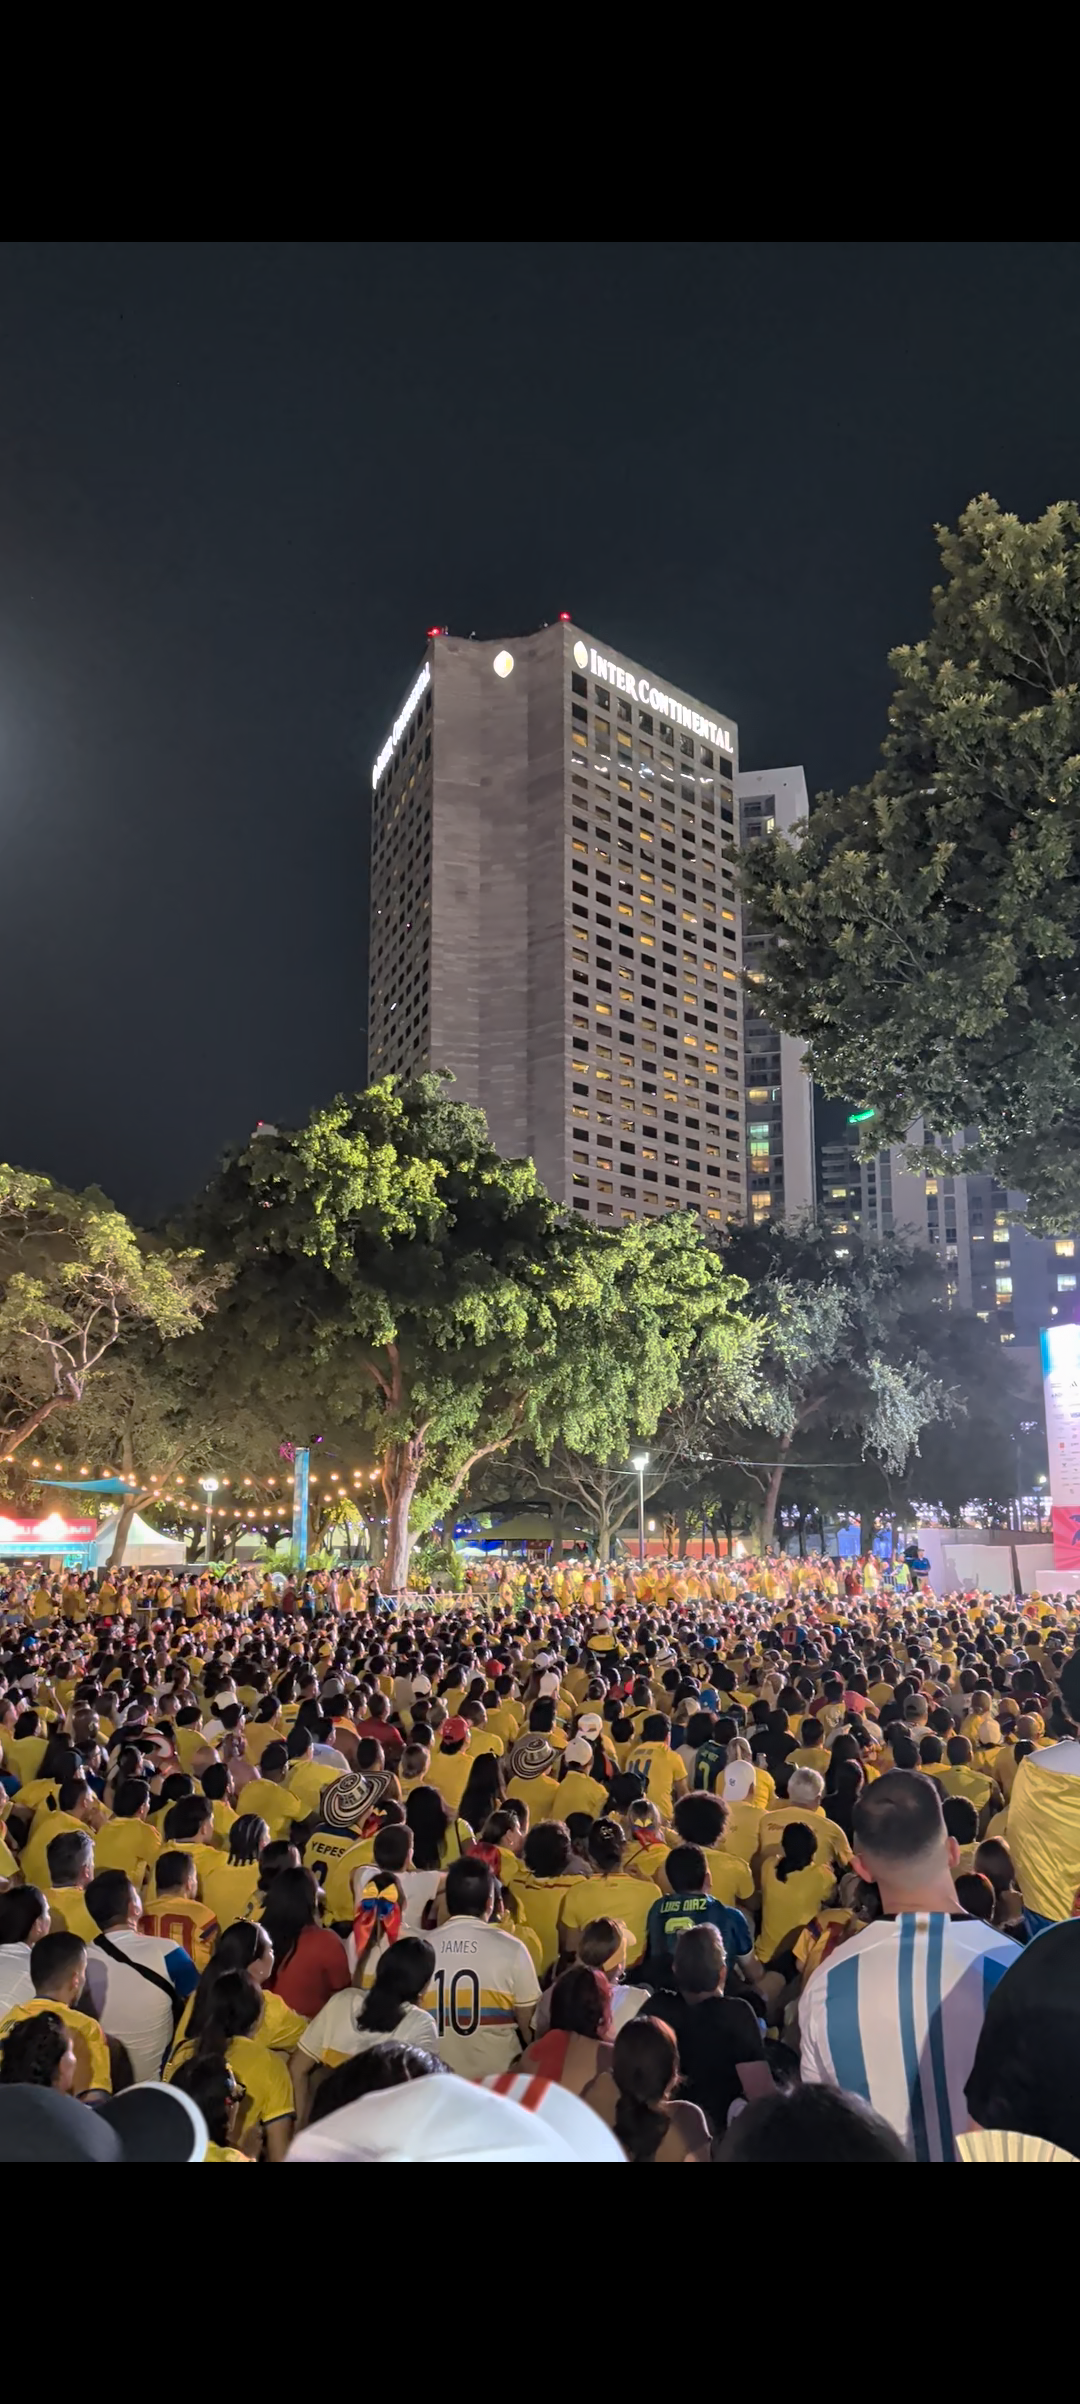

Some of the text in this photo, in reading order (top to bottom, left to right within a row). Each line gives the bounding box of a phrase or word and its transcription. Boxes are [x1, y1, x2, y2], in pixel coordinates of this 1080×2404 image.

[311, 1841, 346, 1858] YEPES
[660, 1898, 707, 1913] LUIS DIAZ
[441, 1940, 478, 1954] JAMES
[434, 1968, 480, 2037] 10
